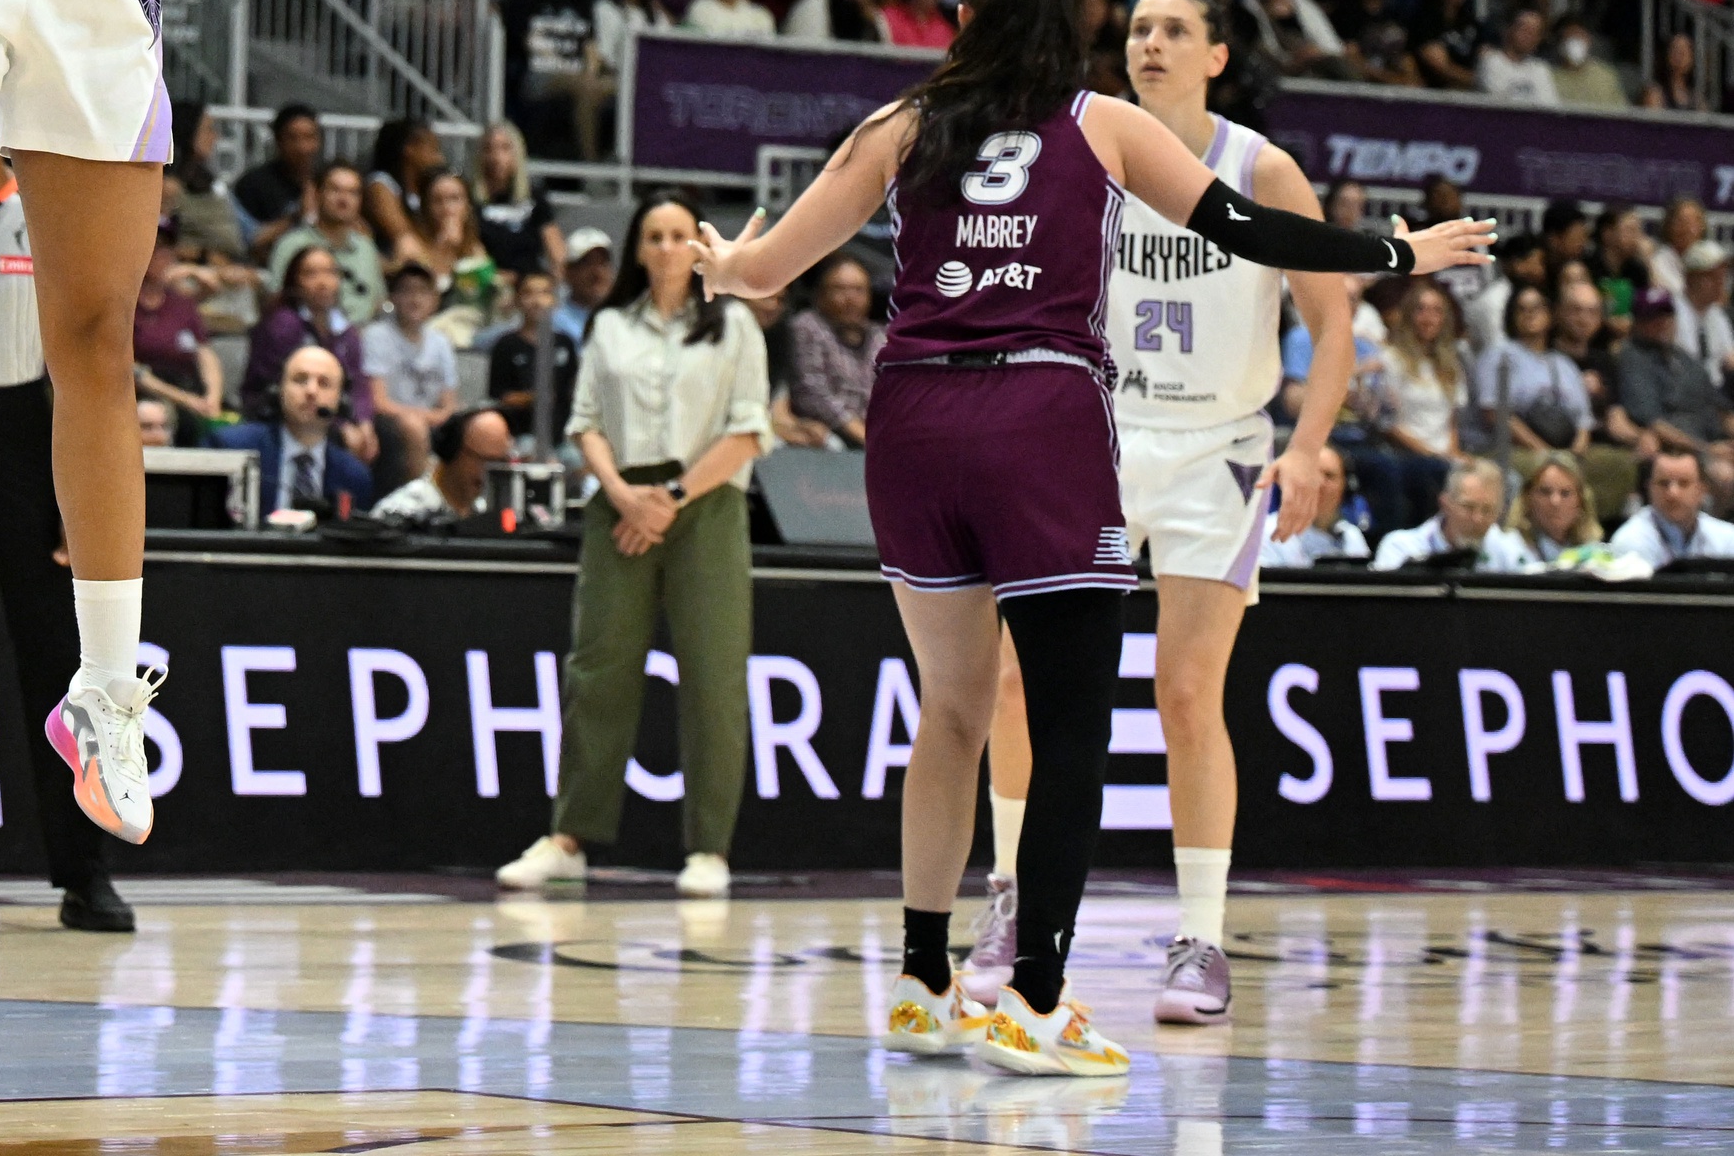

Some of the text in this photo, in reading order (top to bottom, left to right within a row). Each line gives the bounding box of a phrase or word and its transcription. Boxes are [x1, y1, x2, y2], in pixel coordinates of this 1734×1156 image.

[961, 130, 1042, 205] 3
[1325, 133, 1481, 185] TEMPO
[956, 215, 1038, 248] MABREY
[1118, 233, 1232, 282] ALKYRIES
[976, 263, 1042, 292] AT&T
[1135, 299, 1193, 353] 24
[1267, 663, 1734, 806] SEPHO
